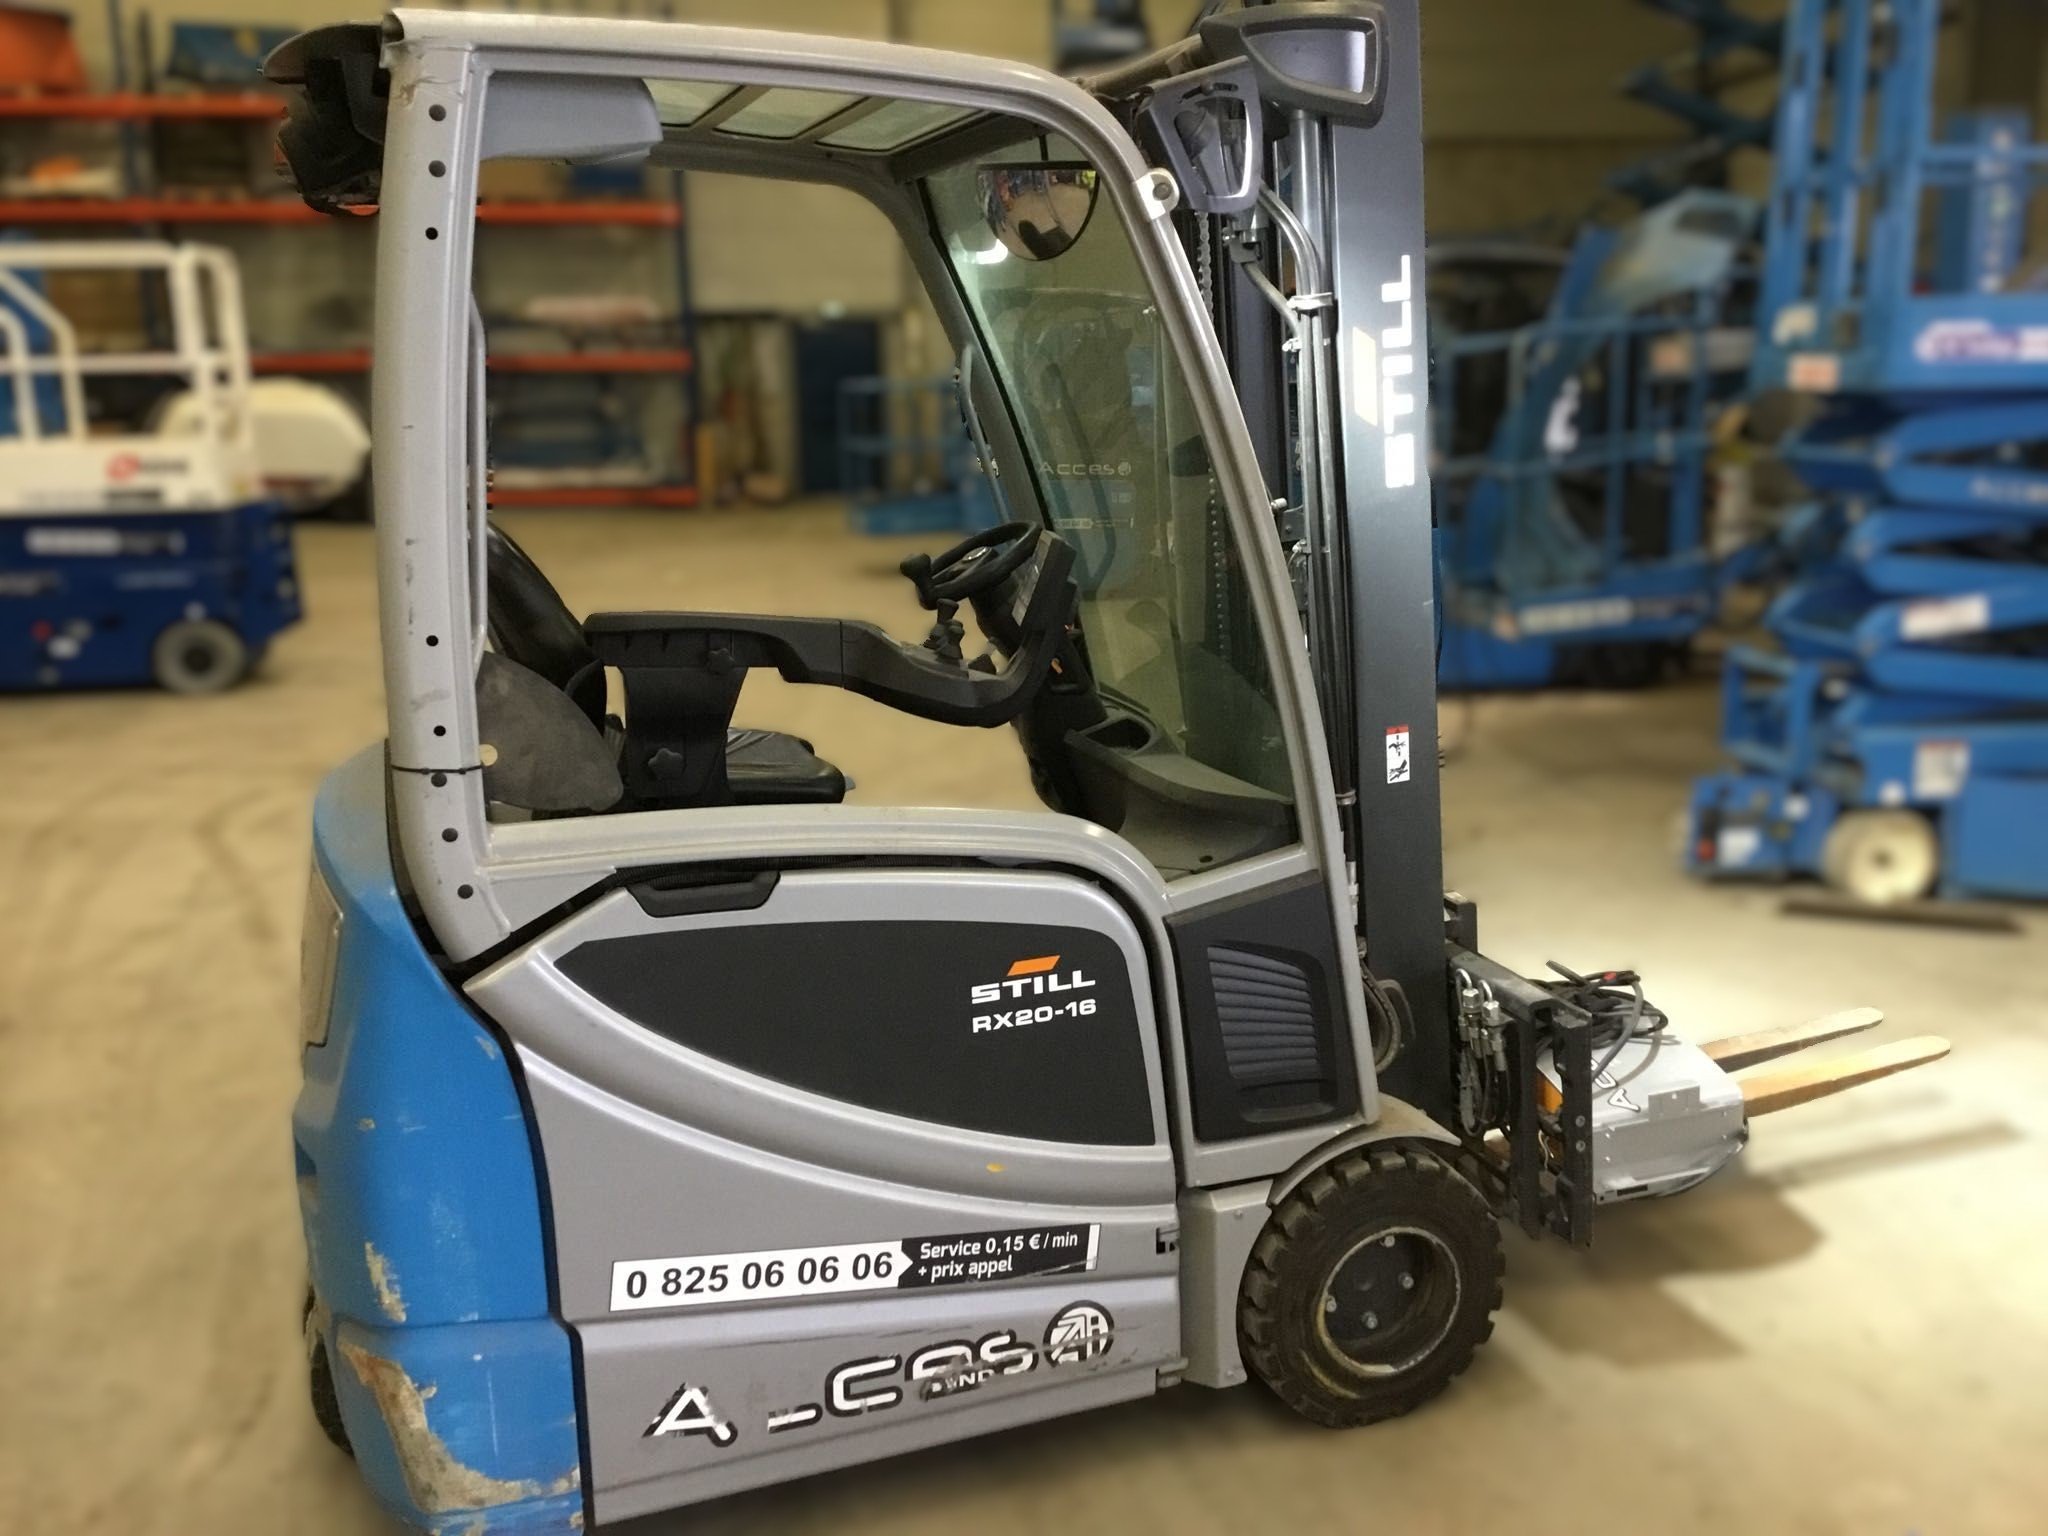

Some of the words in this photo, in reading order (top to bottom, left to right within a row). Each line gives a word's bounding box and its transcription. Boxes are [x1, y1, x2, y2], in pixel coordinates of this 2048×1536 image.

[1381, 254, 1415, 489] STILL
[971, 969, 1096, 1004] STILL
[972, 998, 1097, 1034] RX20-16
[920, 1242, 981, 1260] Service
[985, 1236, 1024, 1255] 0,15
[1028, 1233, 1041, 1249] €
[1052, 1231, 1078, 1248] min
[626, 1270, 647, 1298] 0
[661, 1264, 729, 1296] 825
[742, 1260, 785, 1289] 06
[798, 1256, 840, 1285] 06
[852, 1251, 893, 1280] 06
[918, 1266, 927, 1276] +
[931, 1261, 963, 1284] prix
[968, 1255, 1013, 1279] appel
